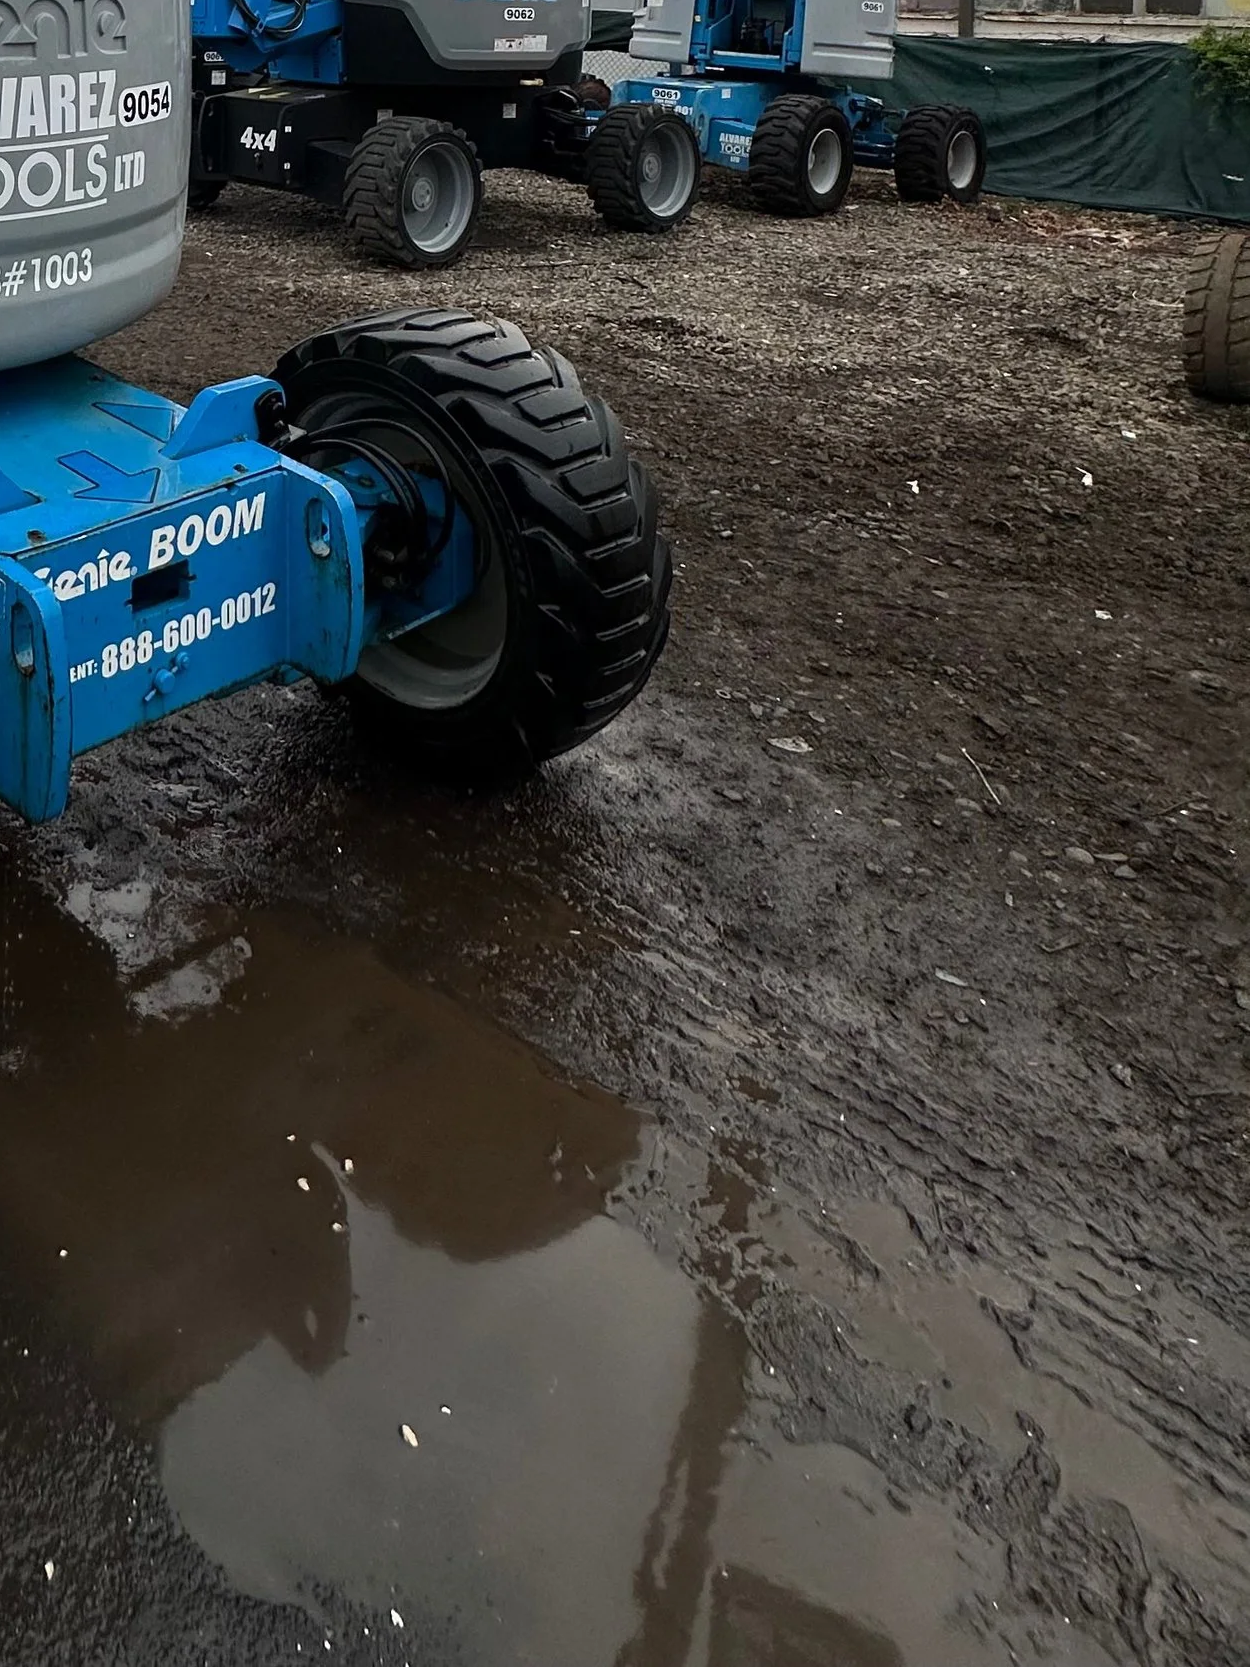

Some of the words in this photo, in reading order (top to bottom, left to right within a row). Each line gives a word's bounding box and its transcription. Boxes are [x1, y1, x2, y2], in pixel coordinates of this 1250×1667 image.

[506, 9, 534, 19] 9062
[123, 86, 170, 123] 9054
[654, 89, 678, 99] 9061
[240, 127, 277, 151] 4x4
[114, 150, 145, 192] LTD
[148, 492, 265, 569] BOOM
[69, 659, 98, 683] ENT:
[101, 582, 276, 678] 888-600-0012
